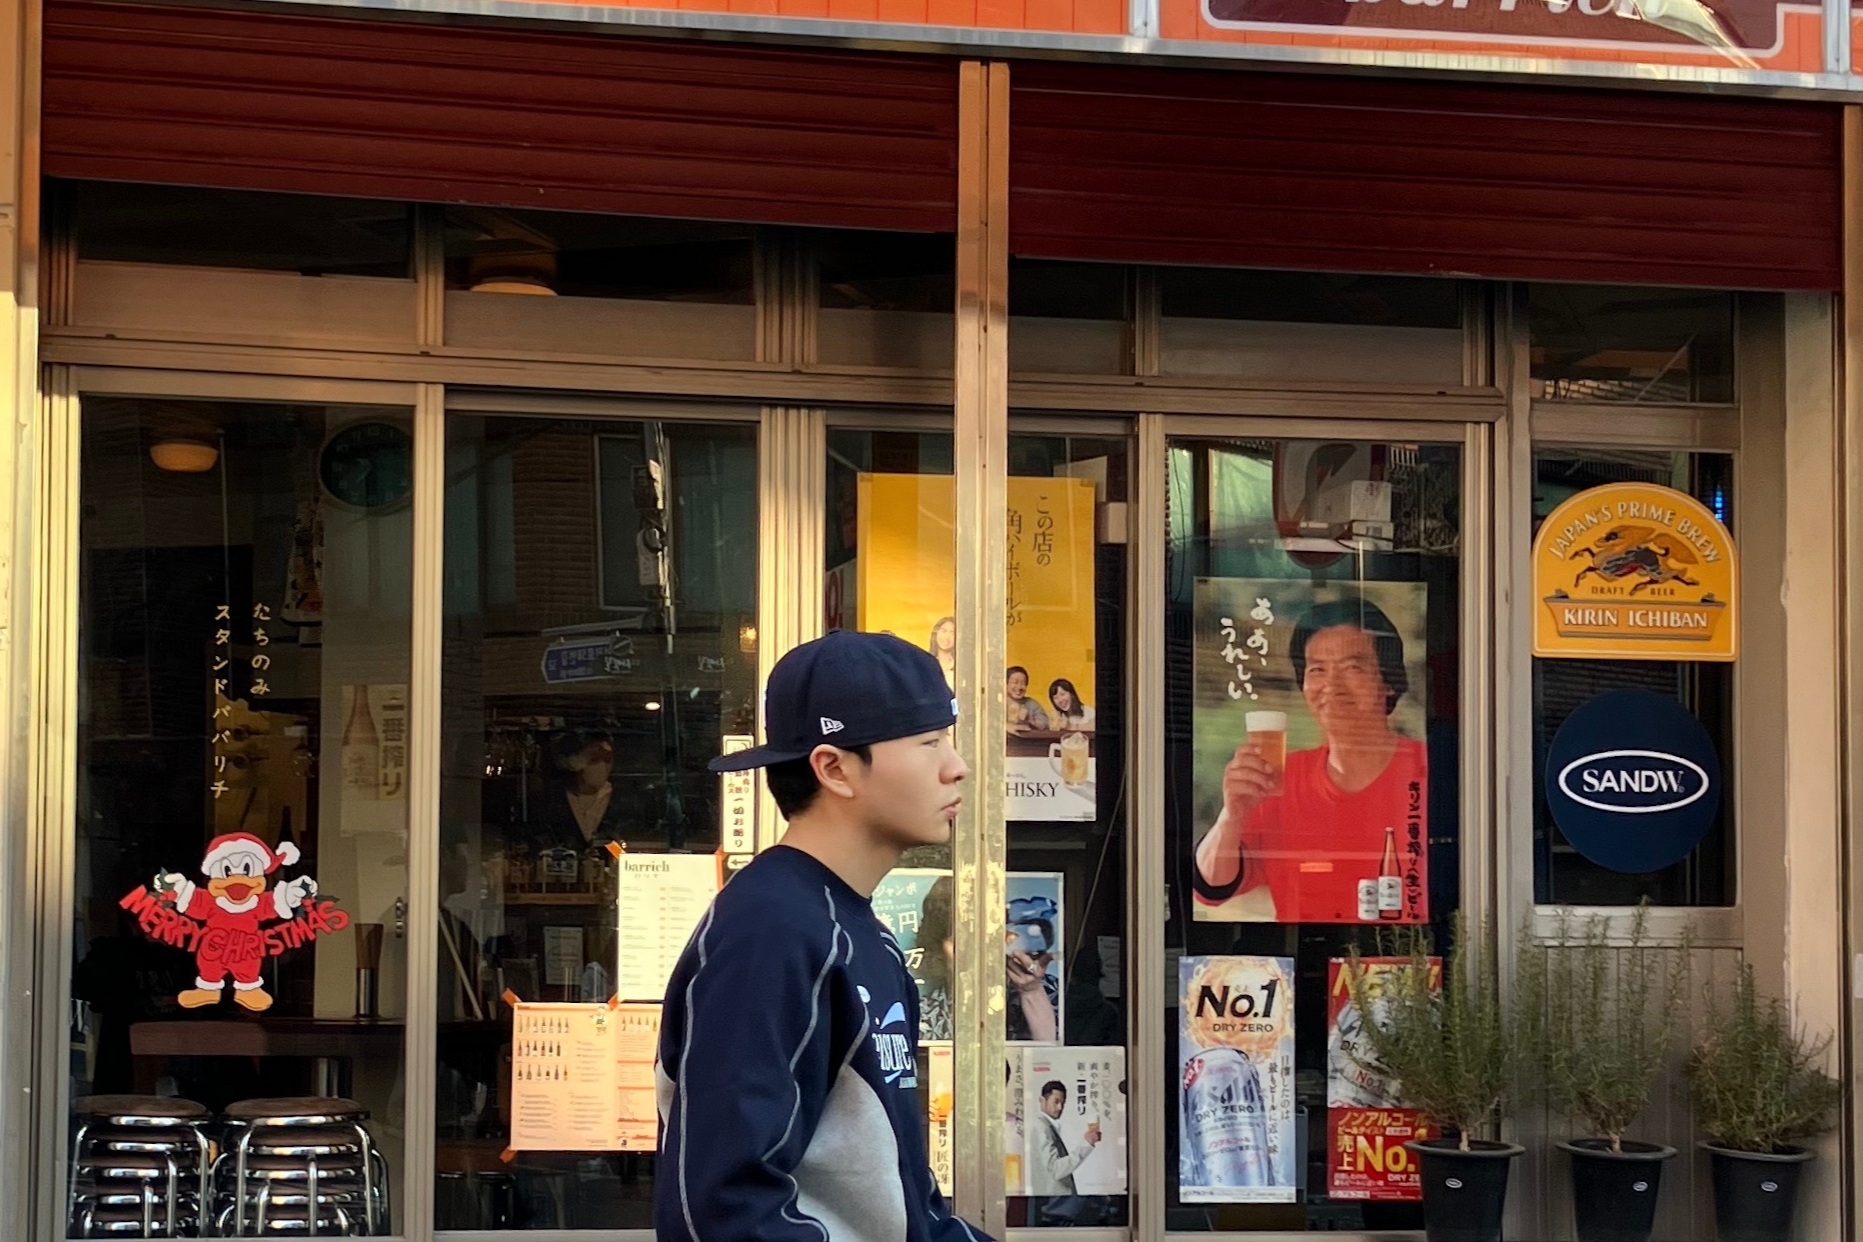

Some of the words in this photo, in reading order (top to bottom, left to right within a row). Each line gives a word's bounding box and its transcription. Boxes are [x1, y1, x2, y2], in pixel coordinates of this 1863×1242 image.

[1032, 495, 1054, 567] この店の
[1618, 501, 1676, 526] PRIME
[1677, 518, 1721, 563] BREW
[1591, 586, 1625, 596] DRAFT
[1650, 588, 1675, 597] BEER
[1564, 608, 1618, 626] KIRIN
[1629, 609, 1708, 629] ICHIBAN
[251, 602, 271, 695] たちのみ
[1005, 781, 1060, 798] HISKY
[1582, 769, 1684, 793] SANDW
[624, 861, 670, 872] barrich
[200, 900, 349, 965] CHRISTMAS
[1195, 978, 1281, 1018] No.1
[1213, 1024, 1236, 1032] DRY
[1240, 1024, 1274, 1033] ZERO
[1222, 1104, 1255, 1114] ZERO
